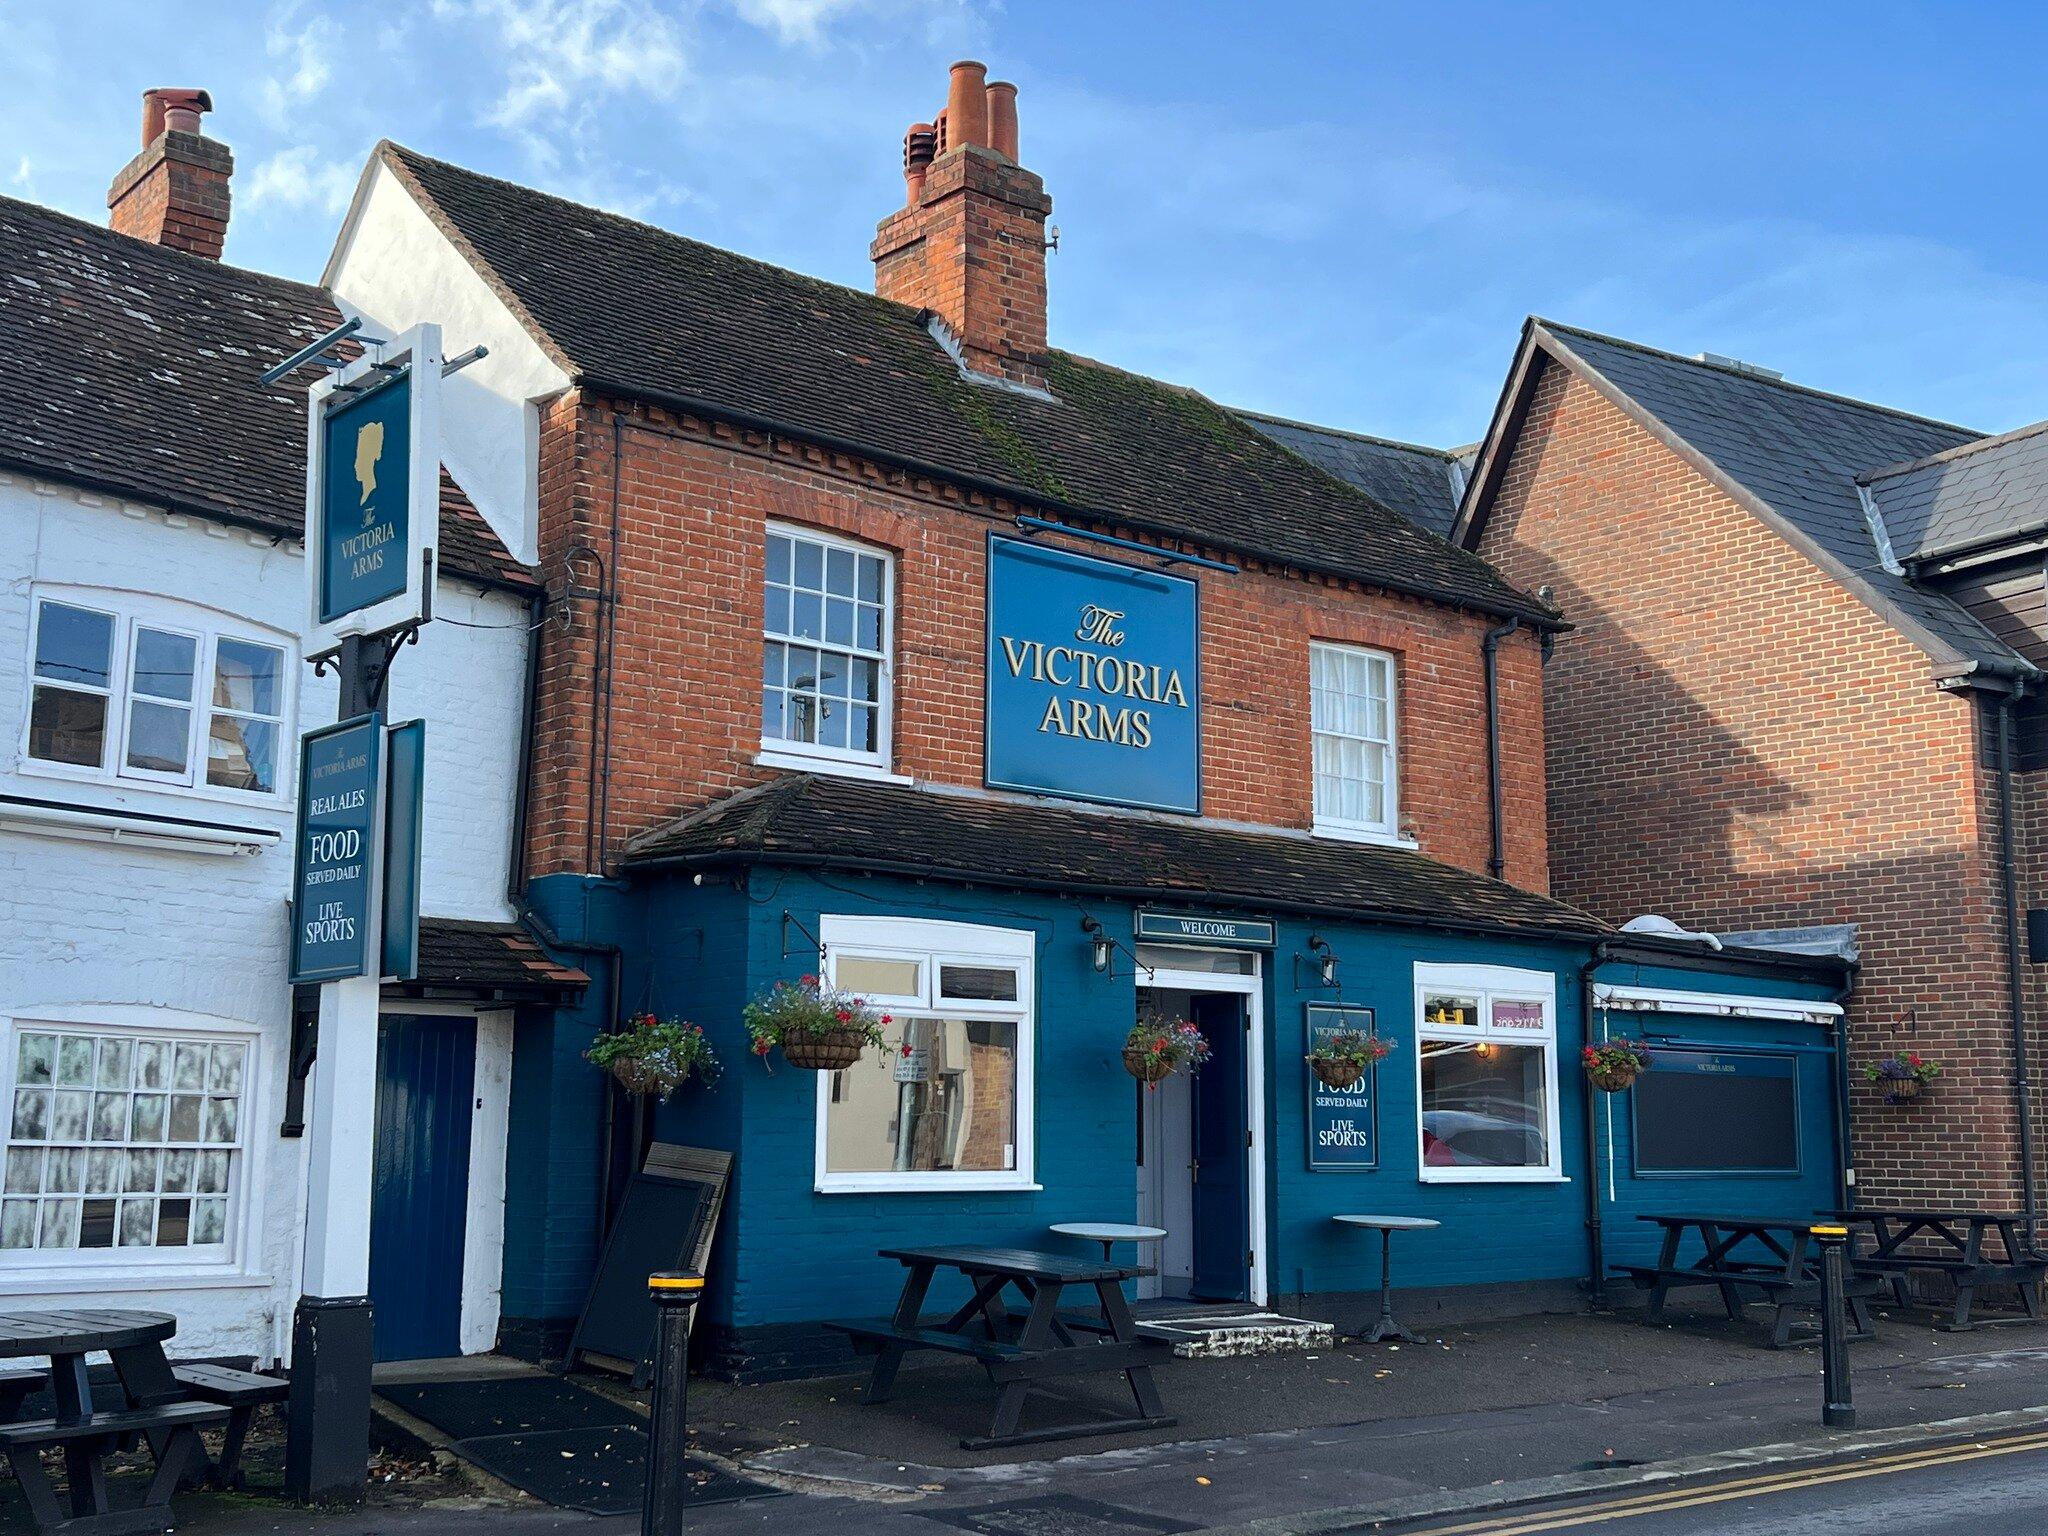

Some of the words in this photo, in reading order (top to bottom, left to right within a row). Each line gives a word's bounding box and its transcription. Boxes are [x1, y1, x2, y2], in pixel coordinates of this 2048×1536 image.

[362, 506, 375, 529] The
[341, 521, 395, 559] VICTORIA
[350, 549, 384, 581] ARMS
[1075, 603, 1126, 647] The
[999, 635, 1189, 708] VICTORIA
[1037, 696, 1152, 748] ARMS
[311, 795, 337, 816] REAL
[338, 789, 365, 810] ALES
[310, 829, 360, 864] FOOD
[306, 868, 336, 886] SERVED
[337, 864, 362, 882] DAILY
[319, 902, 343, 920] LIVE
[305, 917, 355, 945] SPORTS
[1181, 921, 1236, 937] WELCOME
[1315, 1096, 1345, 1107] SERVED
[1346, 1097, 1368, 1108] DAILY
[1319, 1130, 1367, 1147] SPORTS
[1332, 1120, 1354, 1131] LIVE
